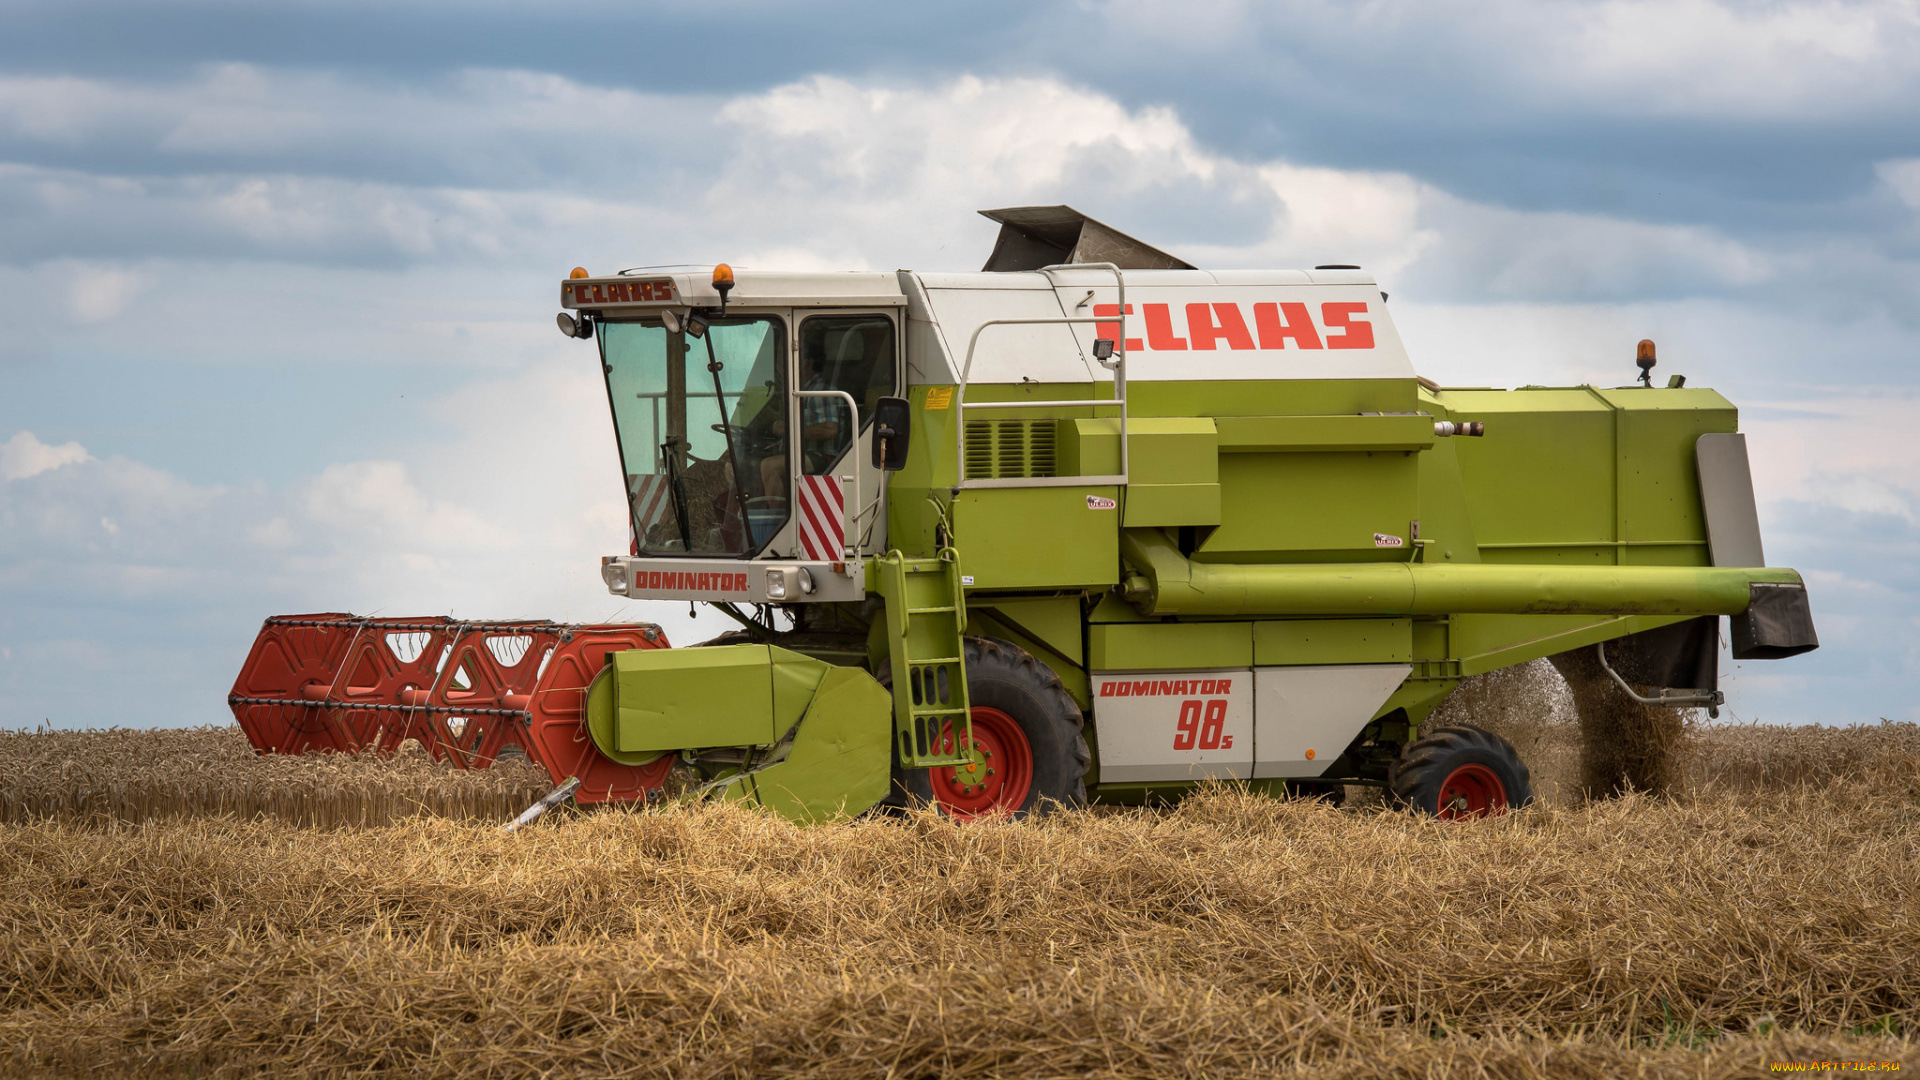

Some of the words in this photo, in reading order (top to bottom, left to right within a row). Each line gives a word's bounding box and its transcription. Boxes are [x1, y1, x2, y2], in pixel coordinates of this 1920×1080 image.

[574, 281, 672, 304] CLAAS
[1093, 302, 1375, 351] CLAAS
[635, 571, 747, 591] DOMINATOR
[1099, 679, 1232, 697] DOMINATOR
